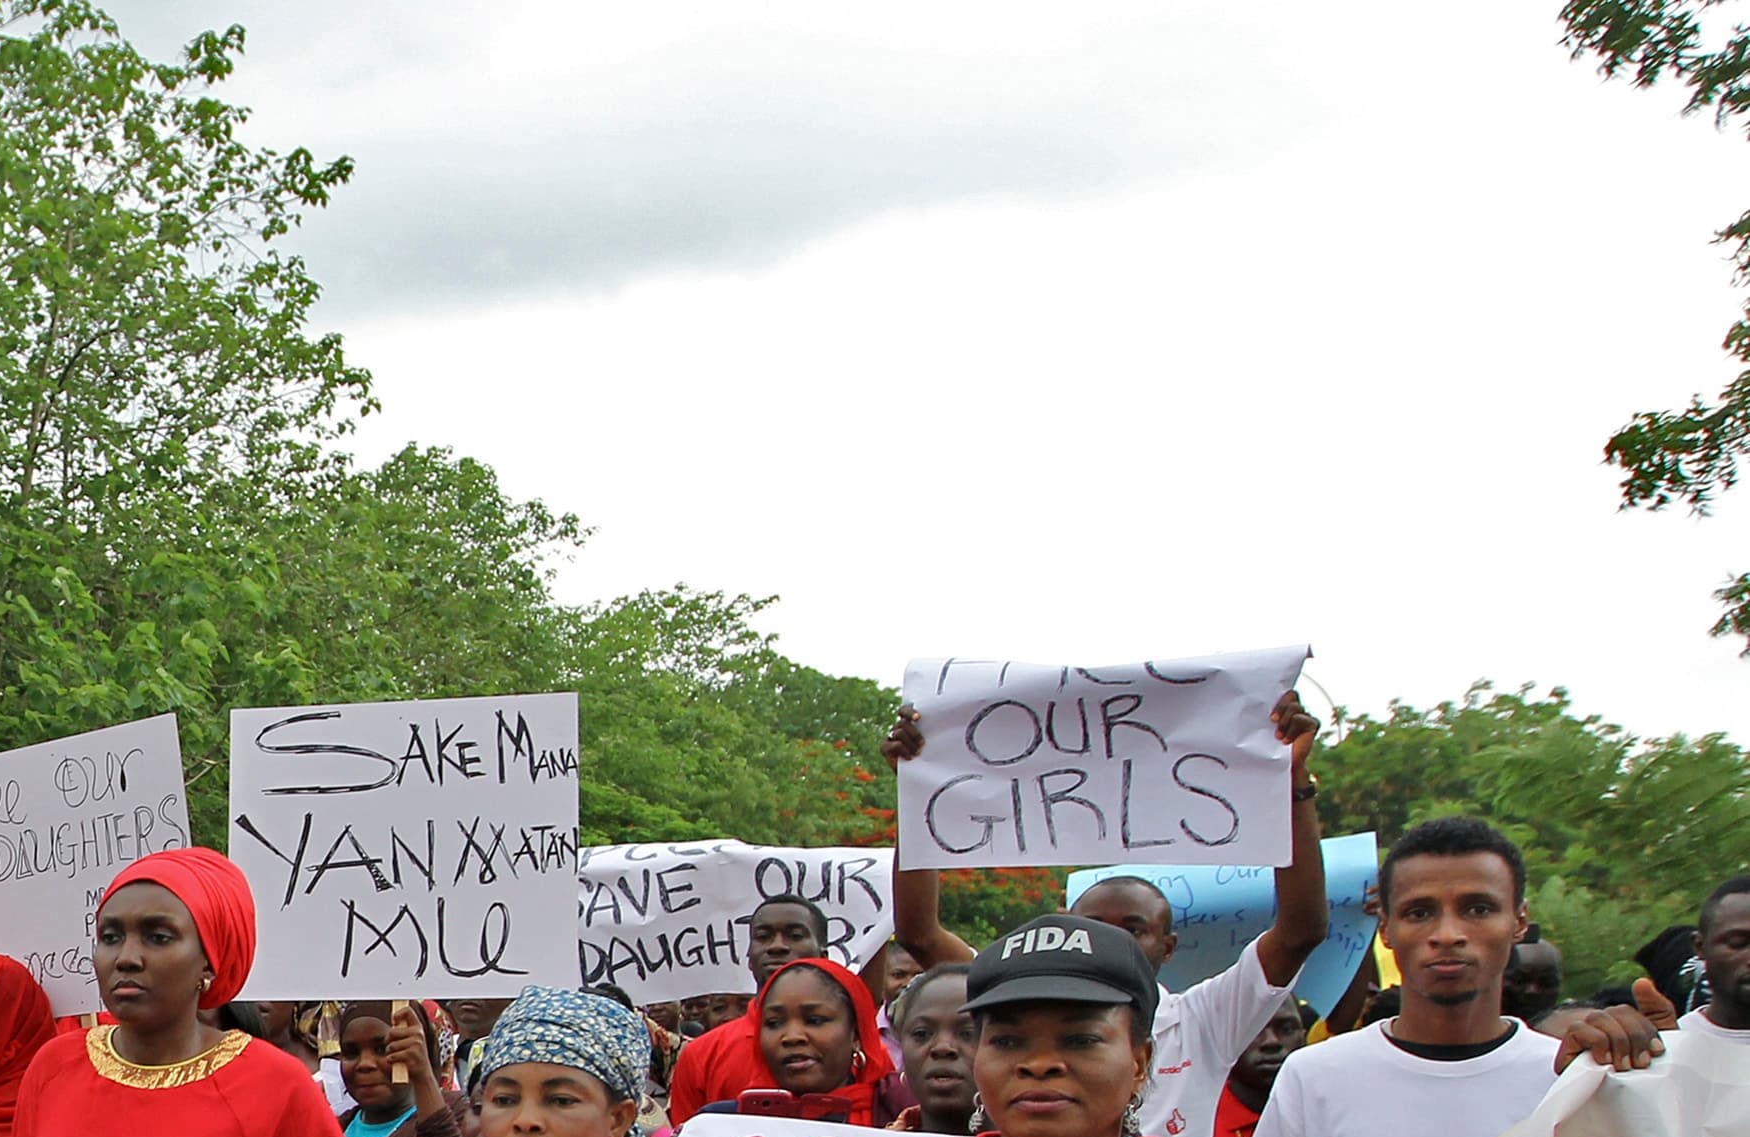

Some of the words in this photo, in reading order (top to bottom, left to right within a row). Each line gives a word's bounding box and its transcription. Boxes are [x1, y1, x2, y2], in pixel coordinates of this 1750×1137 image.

[255, 711, 482, 794] SAKE
[966, 694, 1168, 767] OUR
[924, 753, 1241, 854] GIRLS
[236, 812, 435, 912] YAN
[754, 857, 883, 912] OUR
[1001, 926, 1093, 960] FIDA
